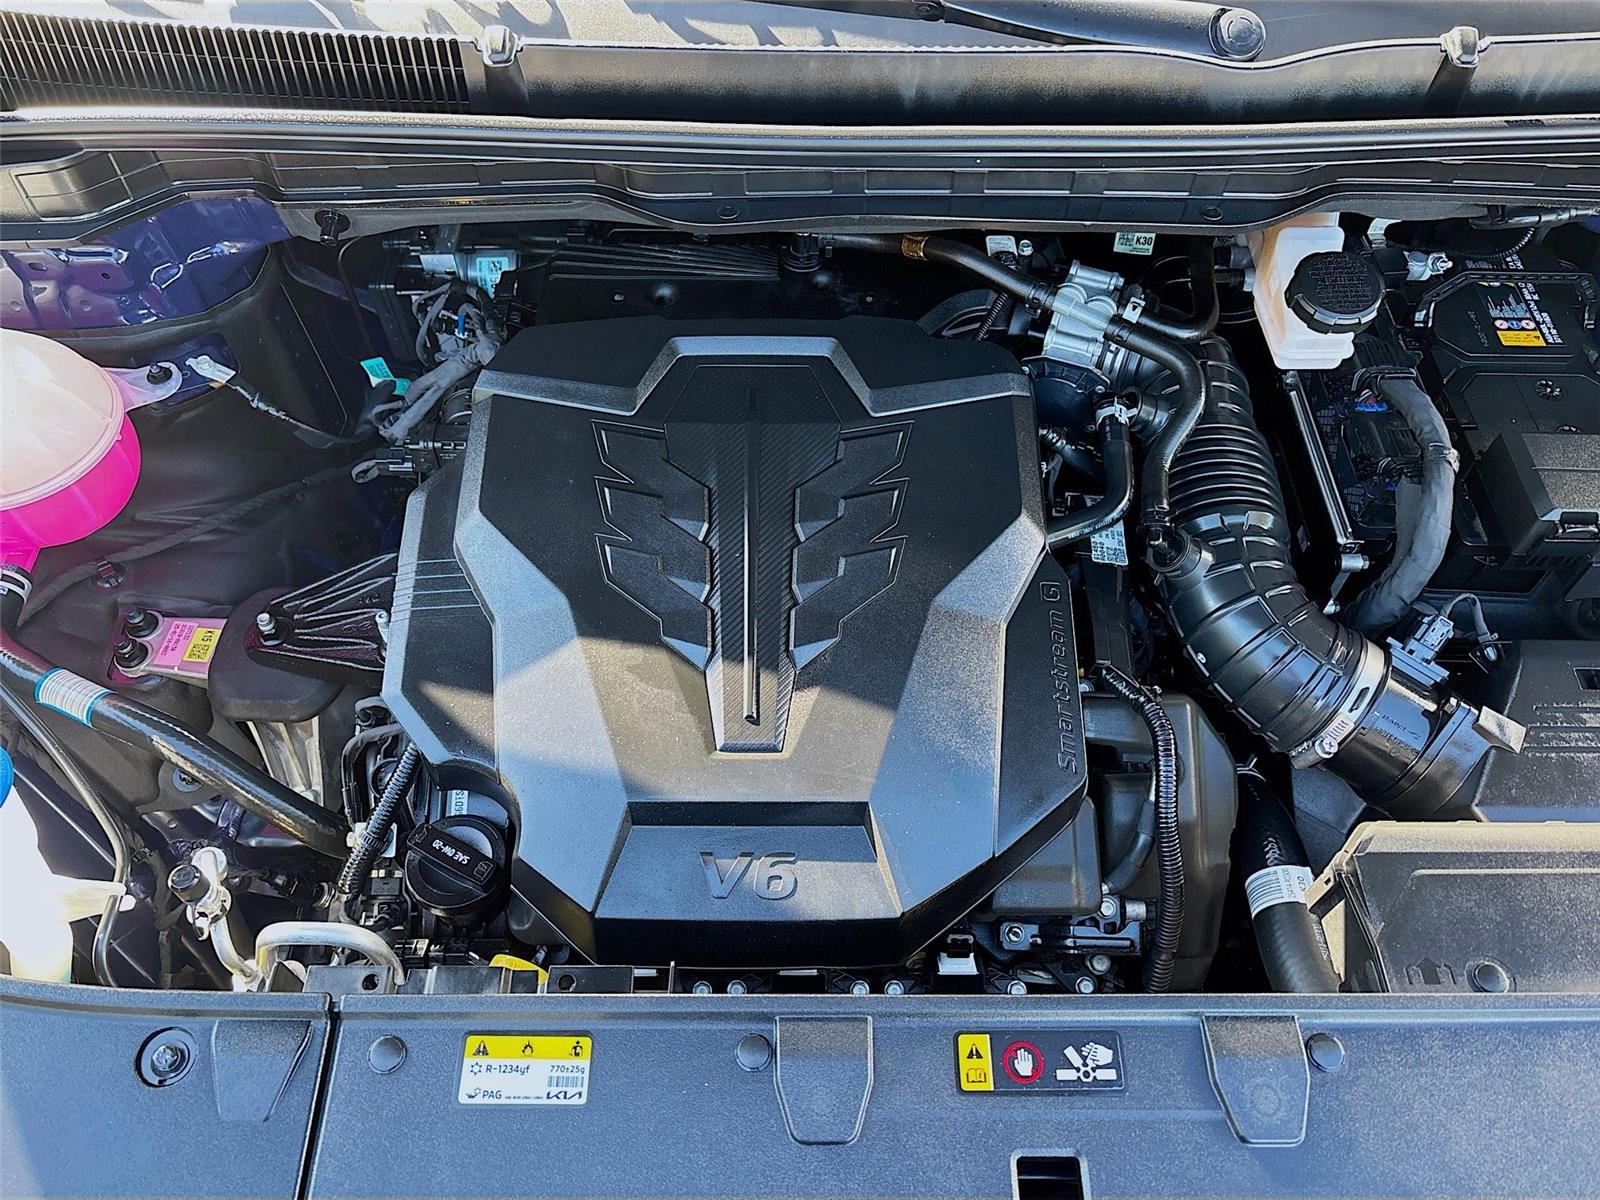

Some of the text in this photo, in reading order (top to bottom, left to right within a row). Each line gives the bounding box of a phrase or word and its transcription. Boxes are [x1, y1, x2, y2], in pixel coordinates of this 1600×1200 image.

[1135, 235, 1153, 246] K30
[201, 630, 215, 642] K15
[1049, 610, 1077, 774] Smartstream
[453, 851, 470, 865] SAE
[700, 851, 798, 900] V6
[486, 1064, 585, 1075] R-1234yf 770±25g
[482, 1090, 502, 1099] PAG
[546, 1090, 583, 1100] KIA
